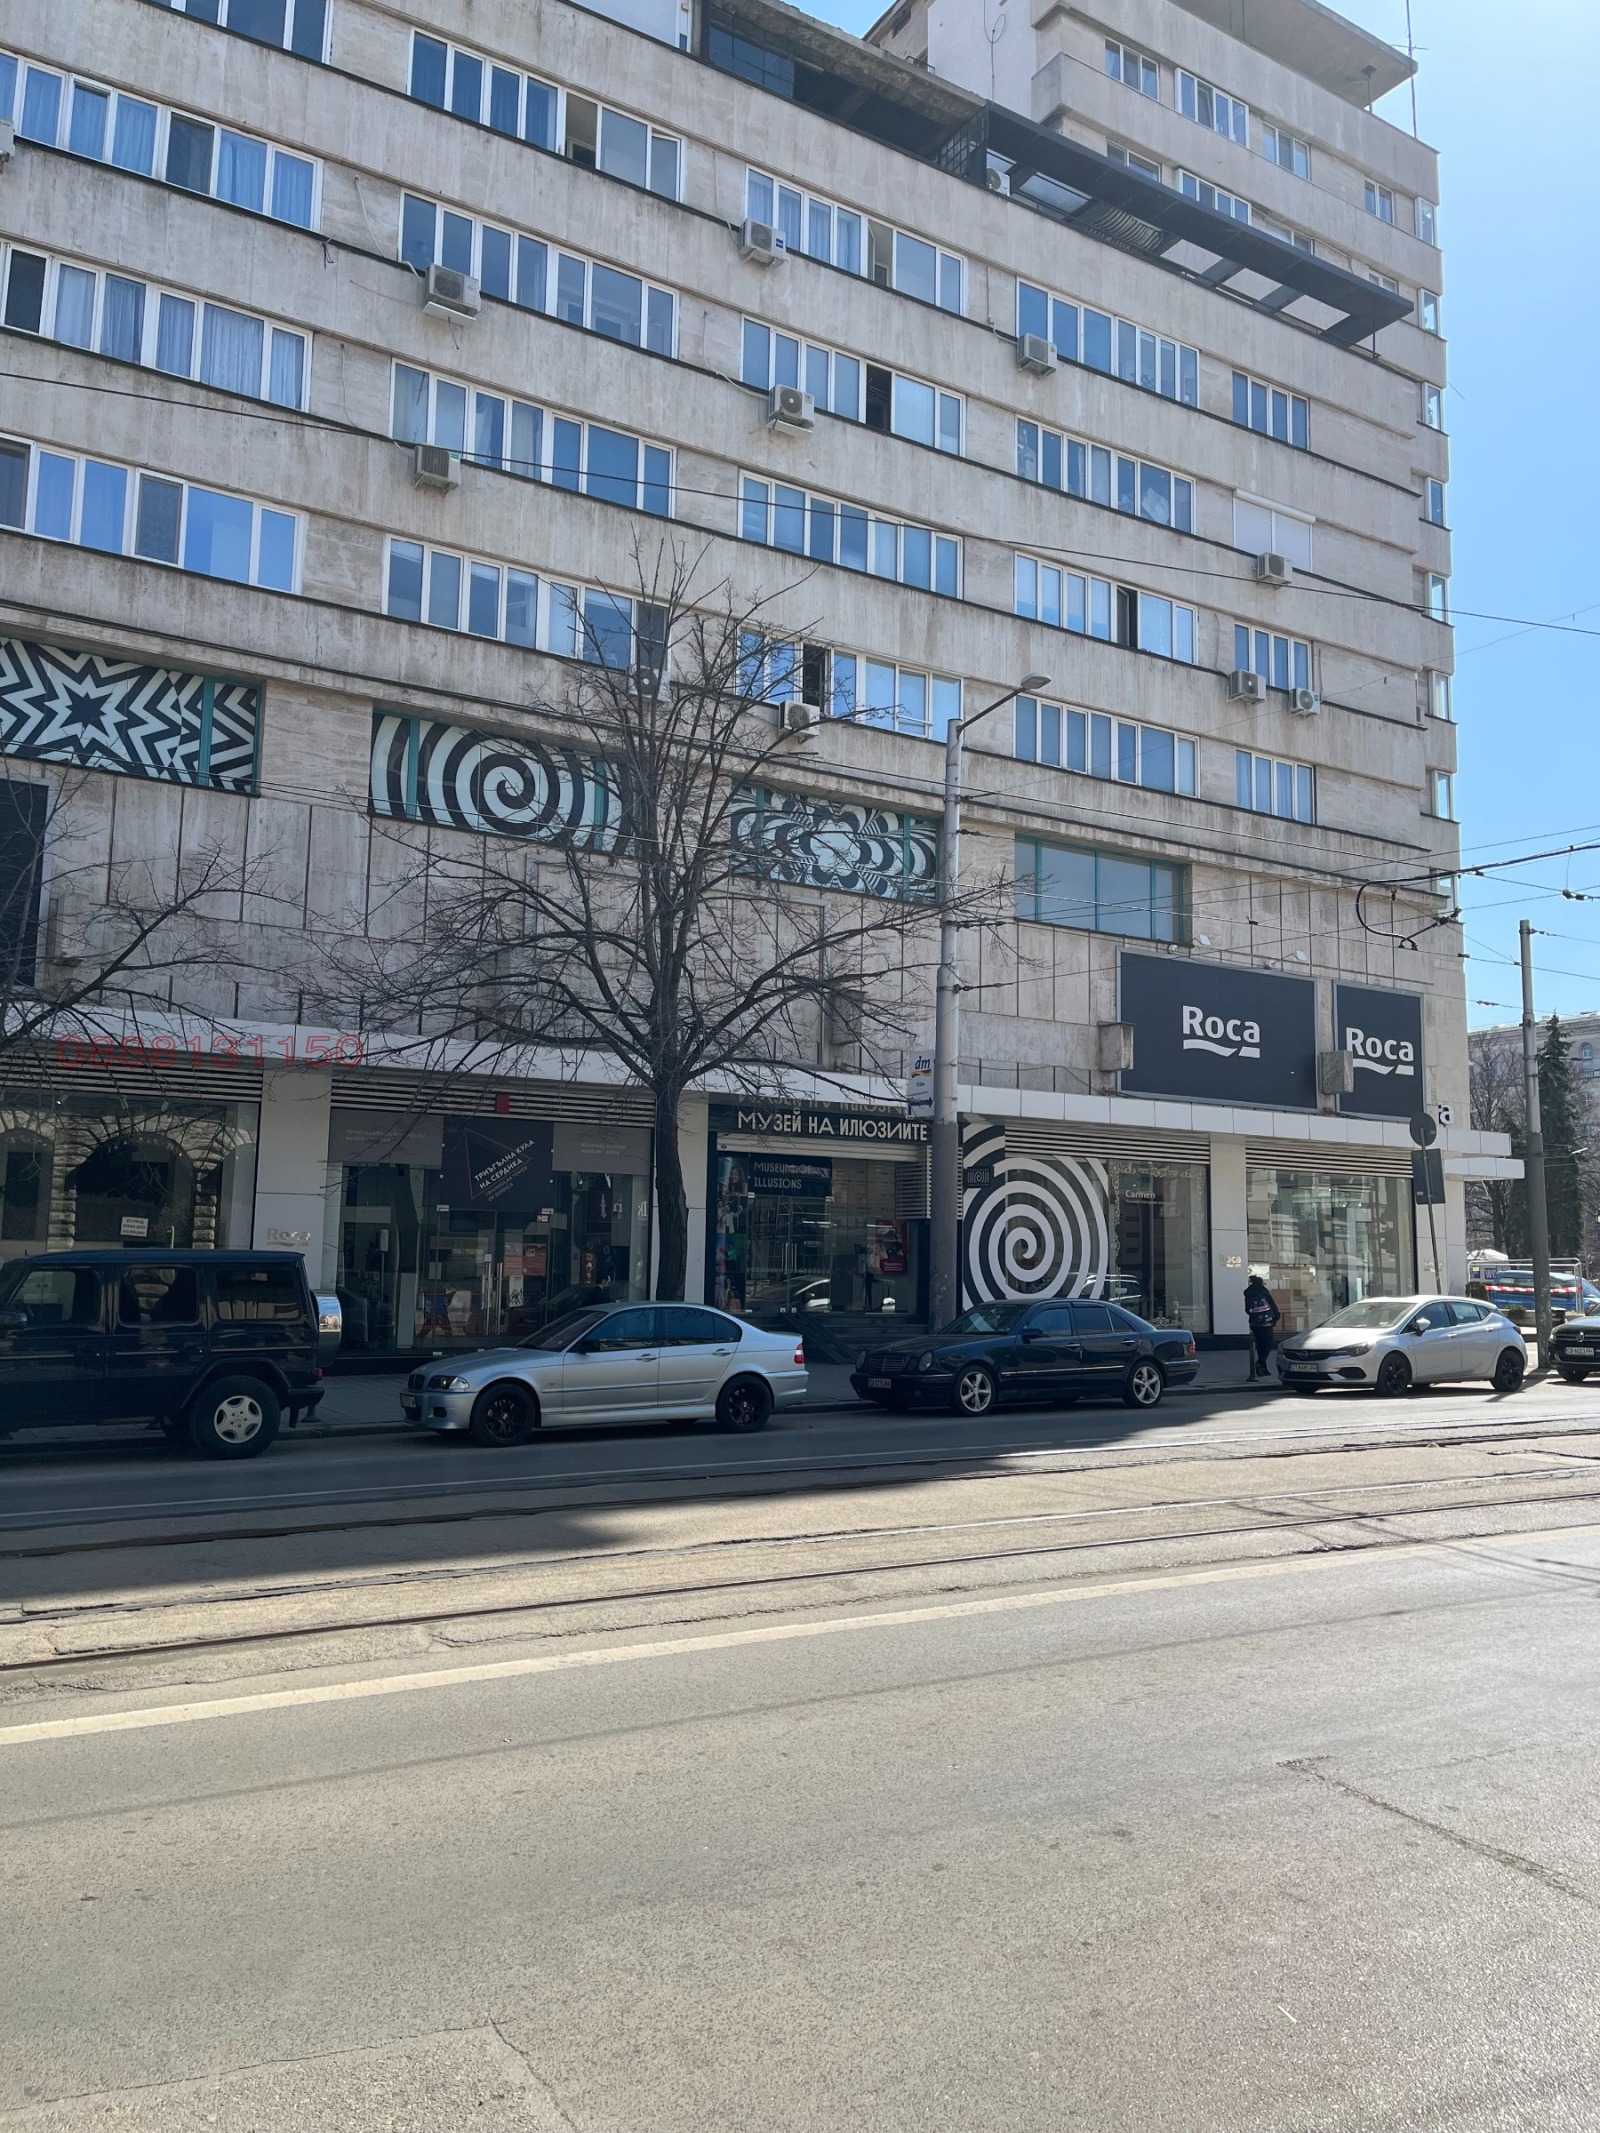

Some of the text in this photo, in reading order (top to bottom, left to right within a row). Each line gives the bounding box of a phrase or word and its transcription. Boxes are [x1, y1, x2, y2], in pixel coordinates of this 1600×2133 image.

[1182, 1005, 1261, 1043] Roca
[1345, 1027, 1415, 1063] Roca
[915, 1056, 931, 1070] dm
[738, 1106, 802, 1134] МУЗЕЙ
[808, 1116, 835, 1135] НА
[839, 1118, 929, 1142] ИЛЮЗИИТЕ
[474, 1139, 535, 1181] ТРИЪГЪЛНА КУЛА
[754, 1161, 799, 1175] MUSEUM
[479, 1158, 523, 1190] НА СЕРДИКА
[754, 1177, 803, 1190] ILLUSIONS
[1125, 1189, 1156, 1200] Carmen
[266, 1228, 311, 1241] Roca
